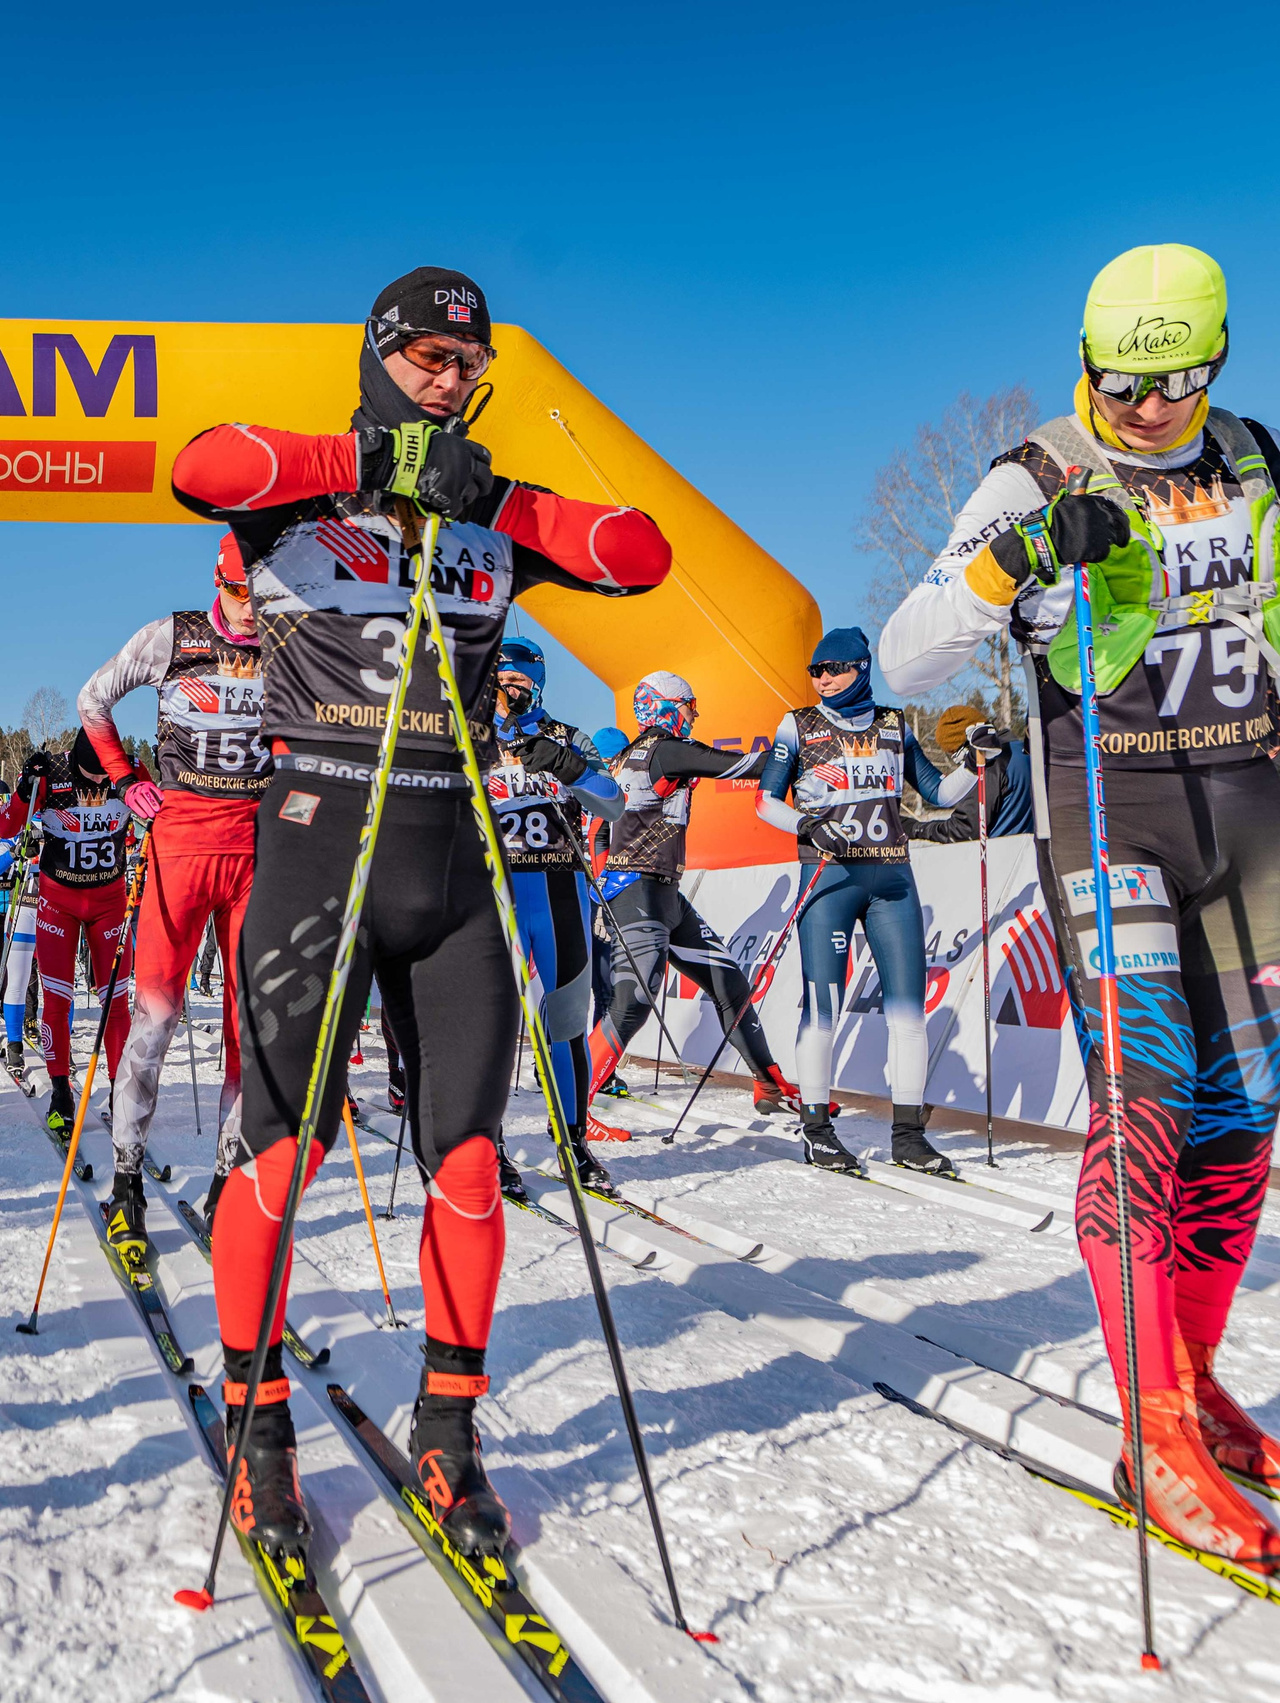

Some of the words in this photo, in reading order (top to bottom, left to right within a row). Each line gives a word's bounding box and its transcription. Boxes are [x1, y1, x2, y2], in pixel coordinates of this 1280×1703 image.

[434, 286, 479, 309] DNB
[403, 434, 420, 474] HIDE
[950, 518, 1002, 557] RAFT
[1176, 534, 1254, 564] KRA
[1179, 556, 1254, 596] LAN
[180, 639, 211, 648] БАМ
[1145, 626, 1259, 717] 75
[225, 699, 266, 717] LAN
[314, 701, 445, 735] КОРОЛЕСКИЕ
[1099, 721, 1243, 754] КОРОЛЕВСКИЕ
[178, 771, 245, 790] КОРОЛЕВСКИЕ
[852, 765, 895, 777] KRAS
[84, 812, 121, 821] KRAS
[84, 820, 119, 833] LAND
[499, 811, 549, 849] 28
[841, 804, 889, 842] 66
[64, 841, 116, 870] 153
[541, 852, 573, 864] КРАСКИ
[606, 854, 629, 866] РАСКИ
